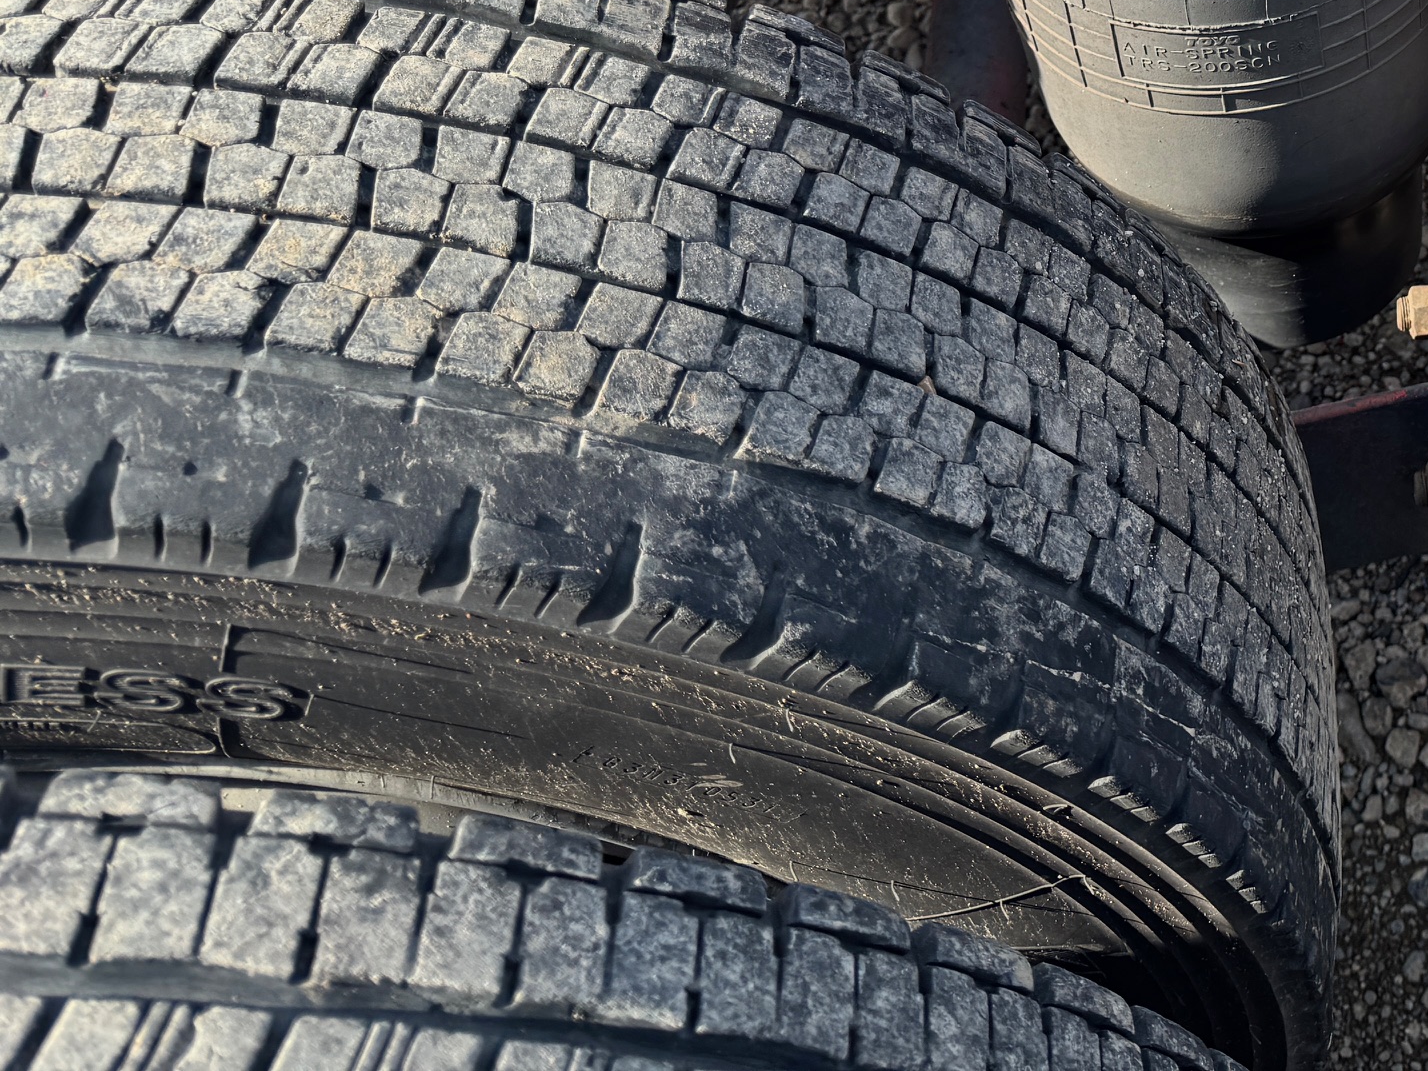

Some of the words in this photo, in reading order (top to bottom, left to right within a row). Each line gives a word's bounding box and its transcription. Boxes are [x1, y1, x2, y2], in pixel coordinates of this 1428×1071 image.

[1123, 39, 1280, 60] AIR-SPRING
[1184, 35, 1240, 47] TOYO
[1123, 53, 1281, 73] TRS-200SCN
